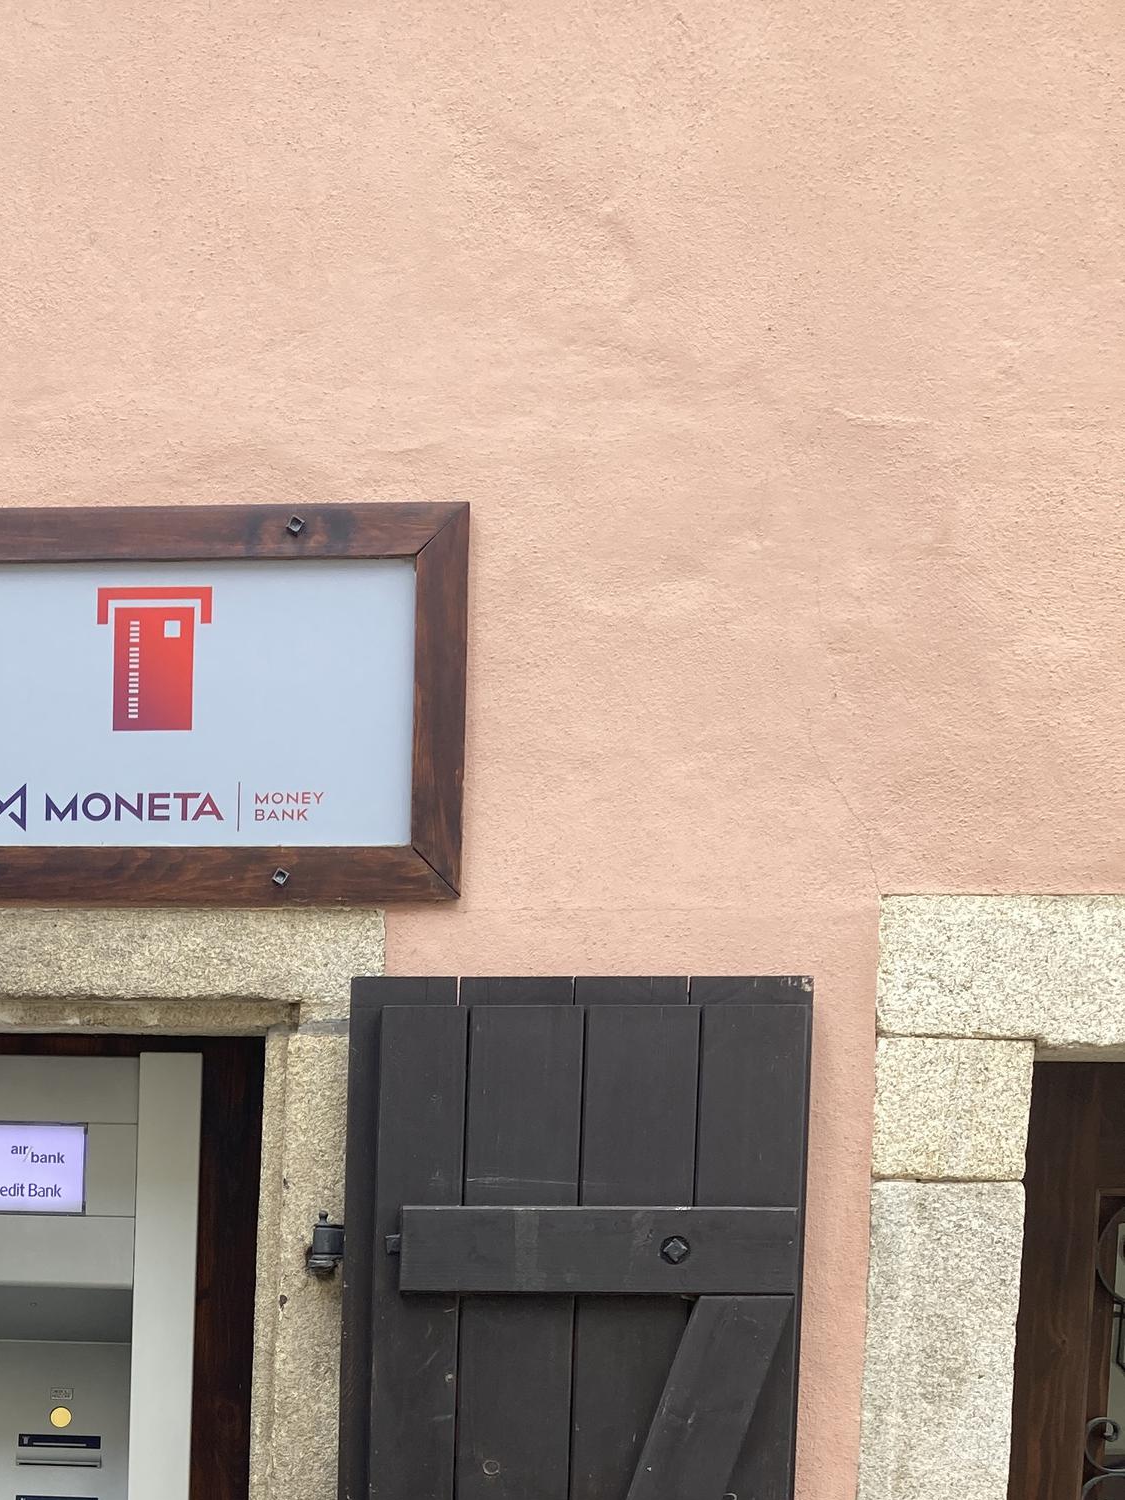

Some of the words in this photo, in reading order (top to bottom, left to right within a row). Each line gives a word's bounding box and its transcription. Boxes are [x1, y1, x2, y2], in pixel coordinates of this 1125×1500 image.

[255, 791, 324, 805] MONEY
[45, 792, 224, 822] MONETA
[255, 809, 309, 822] BANK
[11, 1144, 29, 1155] air
[31, 1152, 65, 1164] bank
[28, 1183, 62, 1198] Bank
